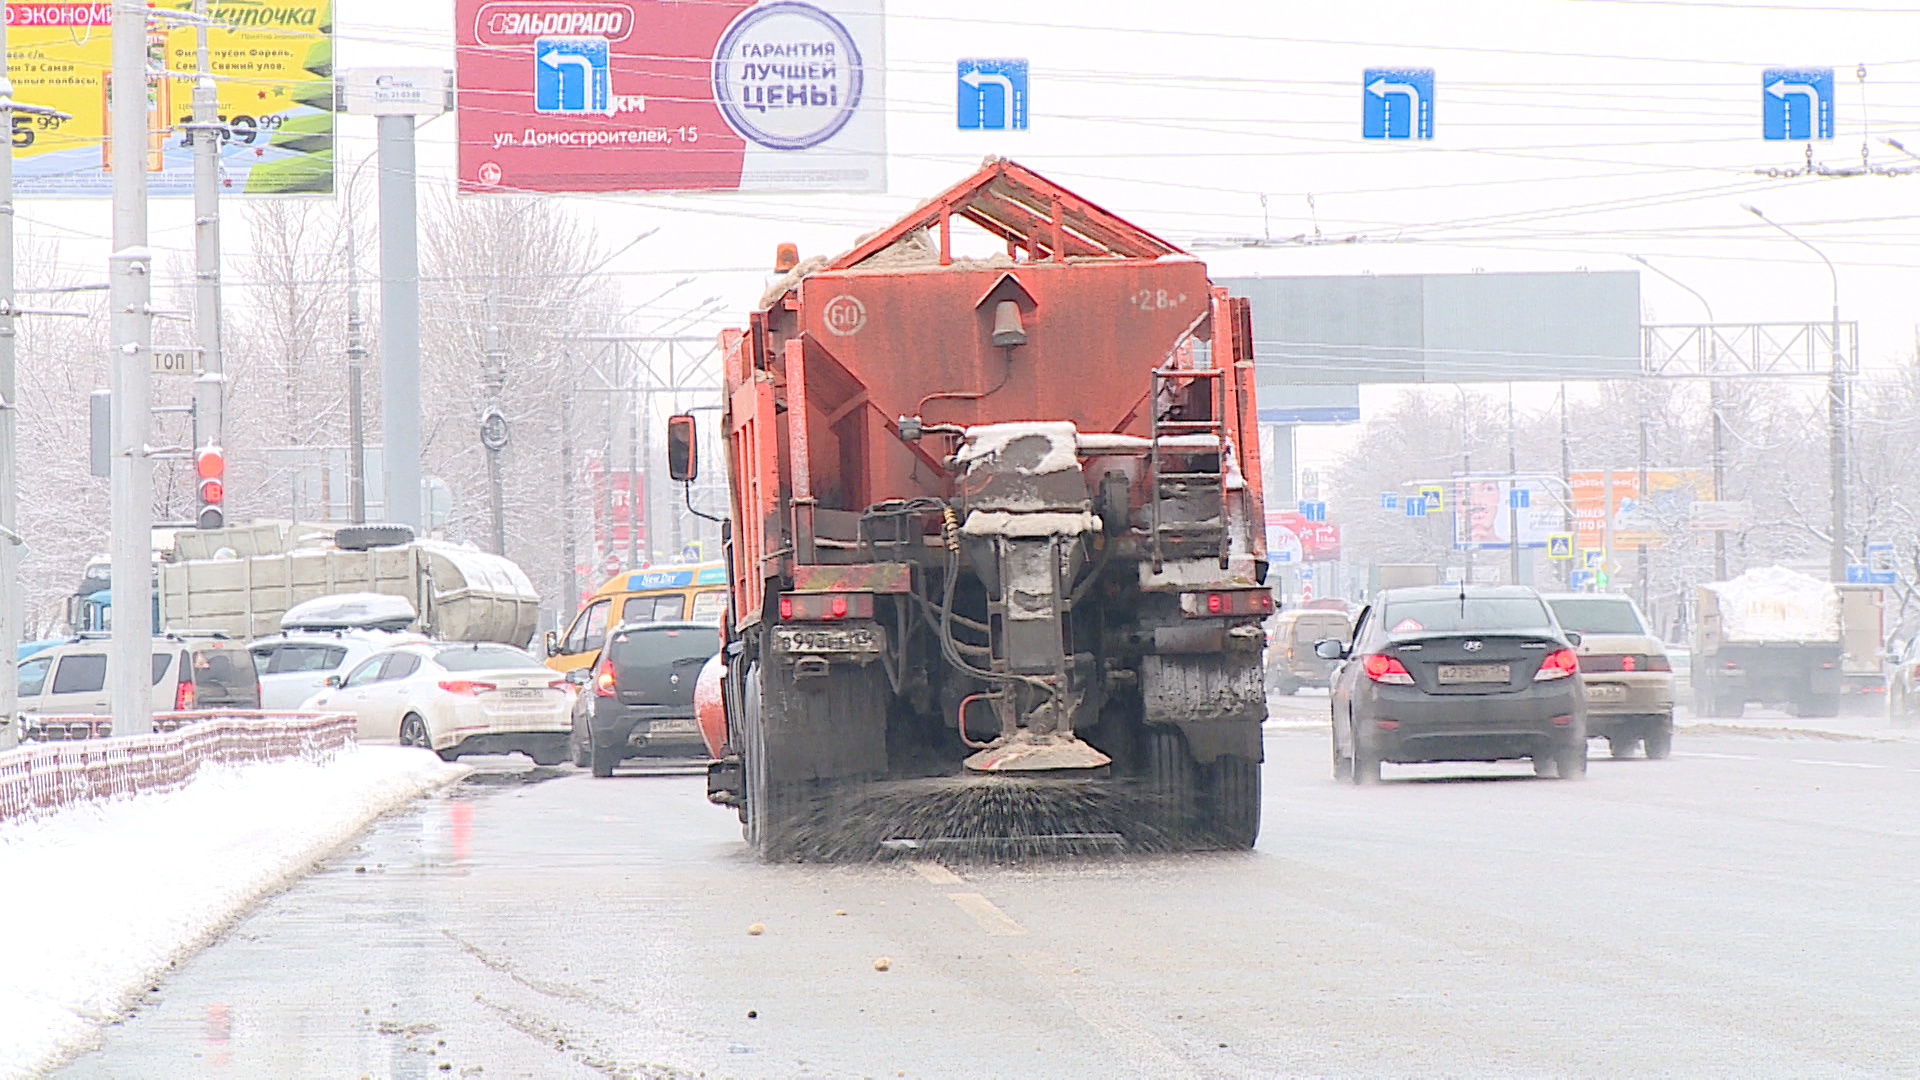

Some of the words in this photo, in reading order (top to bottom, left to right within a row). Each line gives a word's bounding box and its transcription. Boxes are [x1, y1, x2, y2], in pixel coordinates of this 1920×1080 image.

[741, 42, 836, 58] ГАРАНТИЯ
[211, 60, 254, 70] Свежий
[740, 59, 837, 80] ЛУЧШЕЙ
[742, 84, 838, 112] ЦЕНЫ
[493, 132, 518, 150] ул.
[522, 127, 673, 148] Домостроителей,
[678, 126, 699, 143] 15
[831, 304, 858, 327] 60
[153, 352, 185, 370] ТОП
